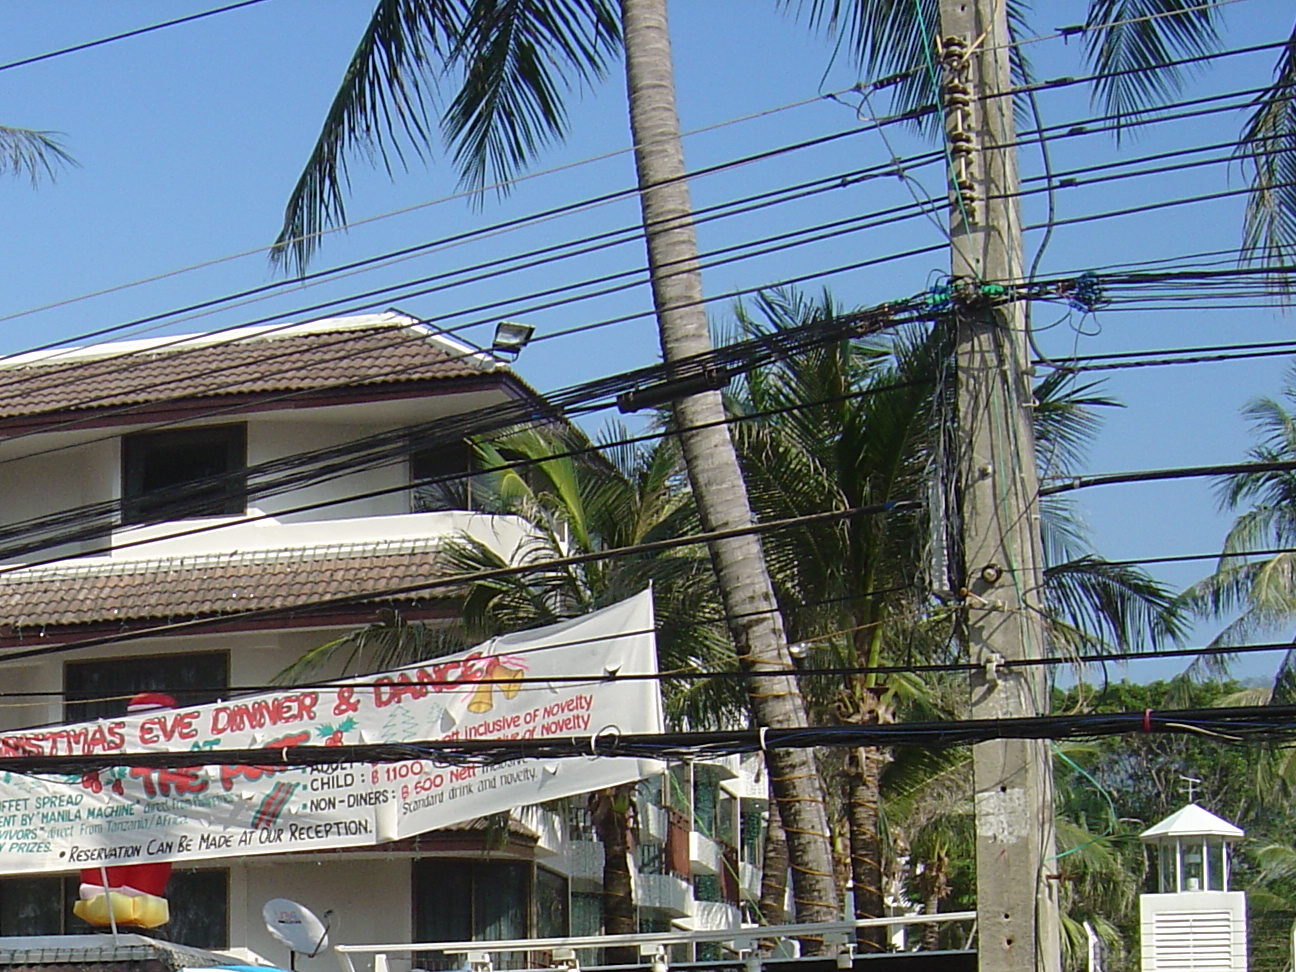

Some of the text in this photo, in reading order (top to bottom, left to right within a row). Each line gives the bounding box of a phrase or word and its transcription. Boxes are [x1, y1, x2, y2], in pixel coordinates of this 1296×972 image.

[139, 711, 200, 745] EVE
[211, 692, 320, 735] DINNER
[334, 687, 361, 715] &
[372, 652, 486, 706] DANCE
[310, 773, 355, 791] CHILD
[415, 773, 444, 794] 500
[477, 777, 497, 793] and
[35, 794, 84, 810] SPREAD
[21, 813, 35, 826] BY
[239, 830, 256, 847] AT
